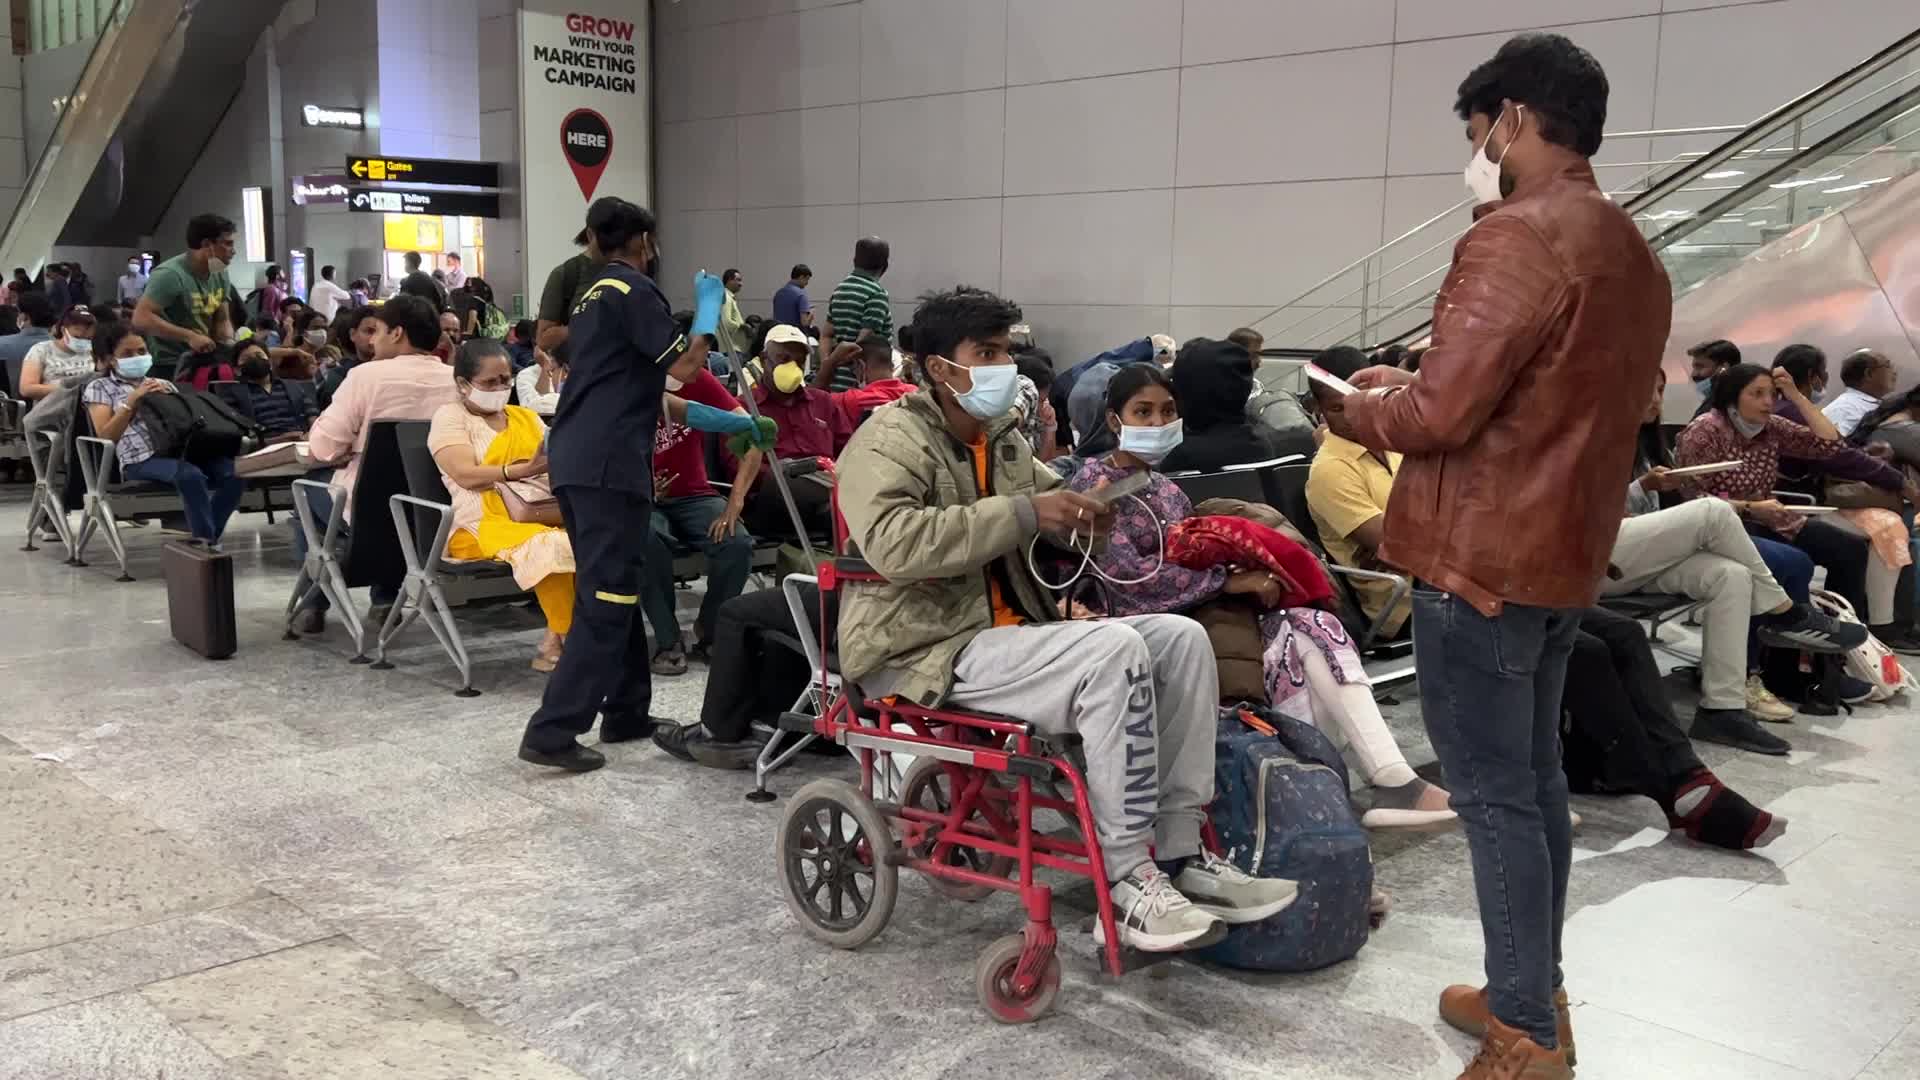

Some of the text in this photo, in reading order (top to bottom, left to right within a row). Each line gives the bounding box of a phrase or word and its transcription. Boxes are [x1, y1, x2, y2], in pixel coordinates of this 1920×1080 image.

[566, 13, 635, 42] GROW
[568, 35, 635, 56] WITH YOUR
[533, 45, 636, 75] MARKETING
[545, 67, 636, 95] CAMPAIGN
[567, 131, 607, 148] HERE
[387, 161, 413, 172] Gates
[402, 193, 431, 204] Toilets
[1124, 663, 1157, 832] VINTAGE
